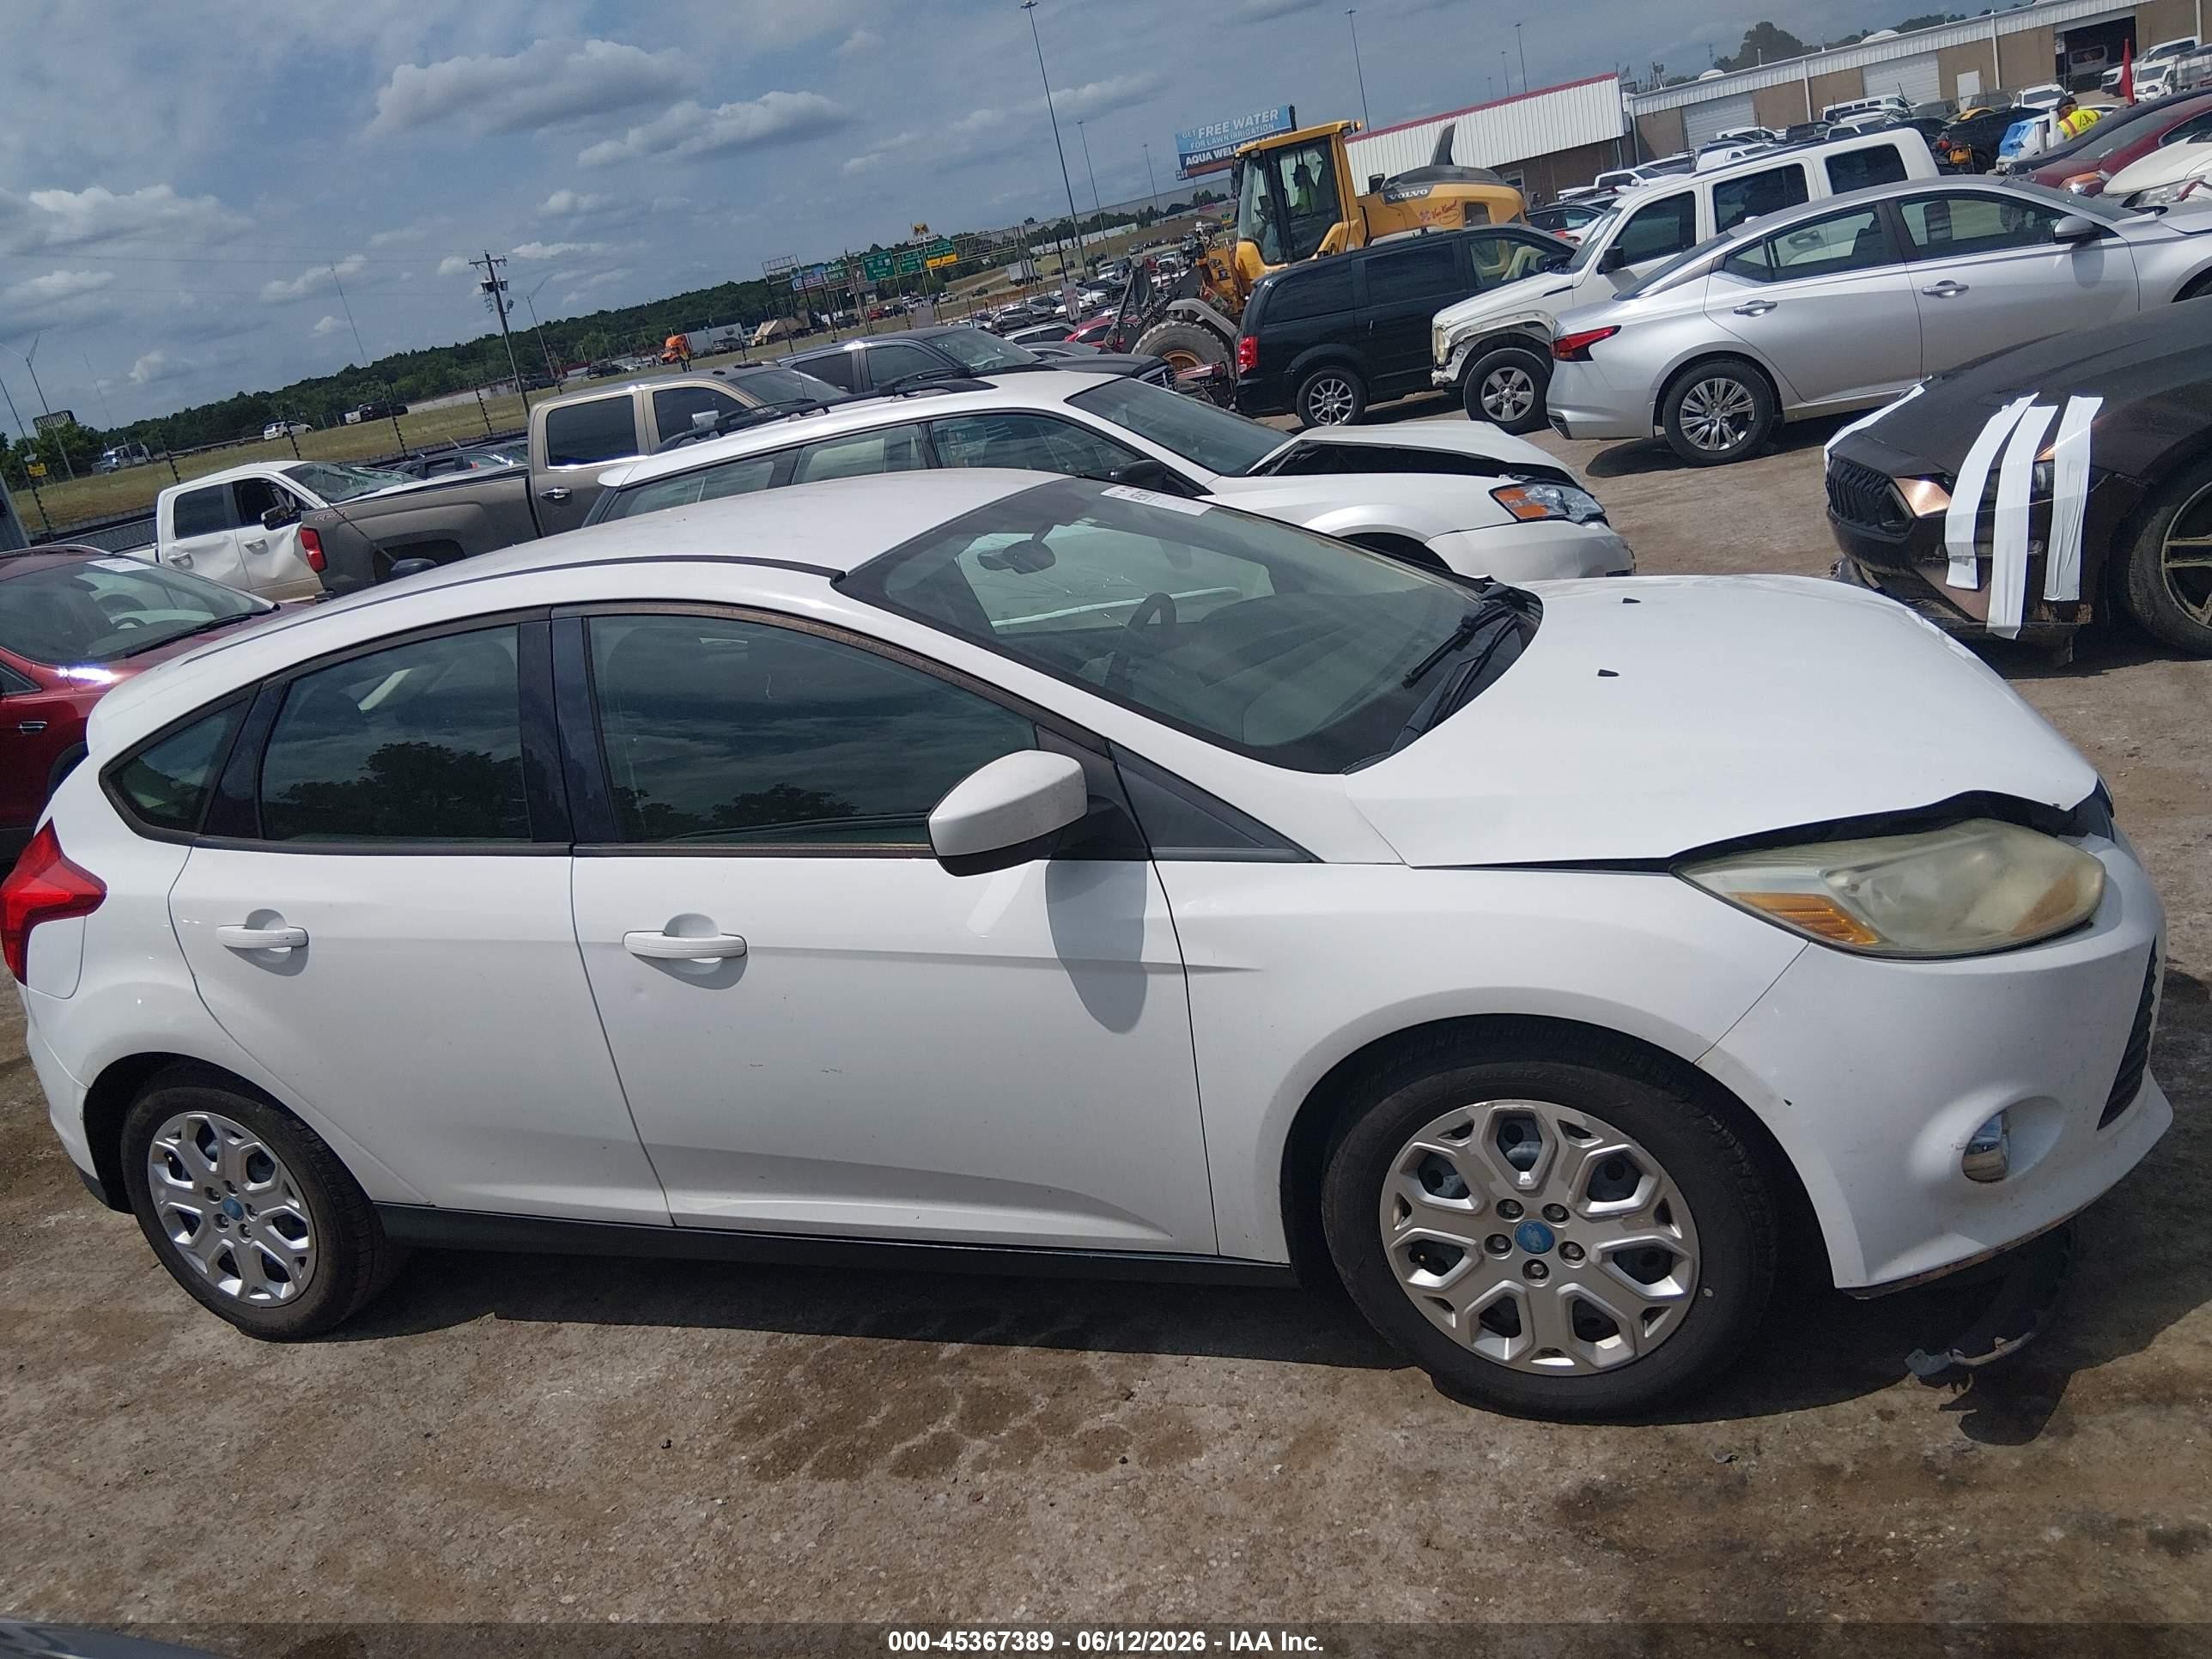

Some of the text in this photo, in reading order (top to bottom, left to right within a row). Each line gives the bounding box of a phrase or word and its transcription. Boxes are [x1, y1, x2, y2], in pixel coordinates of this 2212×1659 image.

[1182, 109, 1279, 139] GET FREE WATER
[1190, 139, 1206, 150] FOR
[1206, 134, 1229, 146] LAWN
[1231, 123, 1274, 139] IRRIGATION
[1186, 151, 1212, 166] AQUA
[1388, 189, 1428, 200] VOLVO
[1133, 317, 1142, 327] DO
[1141, 305, 1154, 319] NOT
[1153, 290, 1170, 307] WALK
